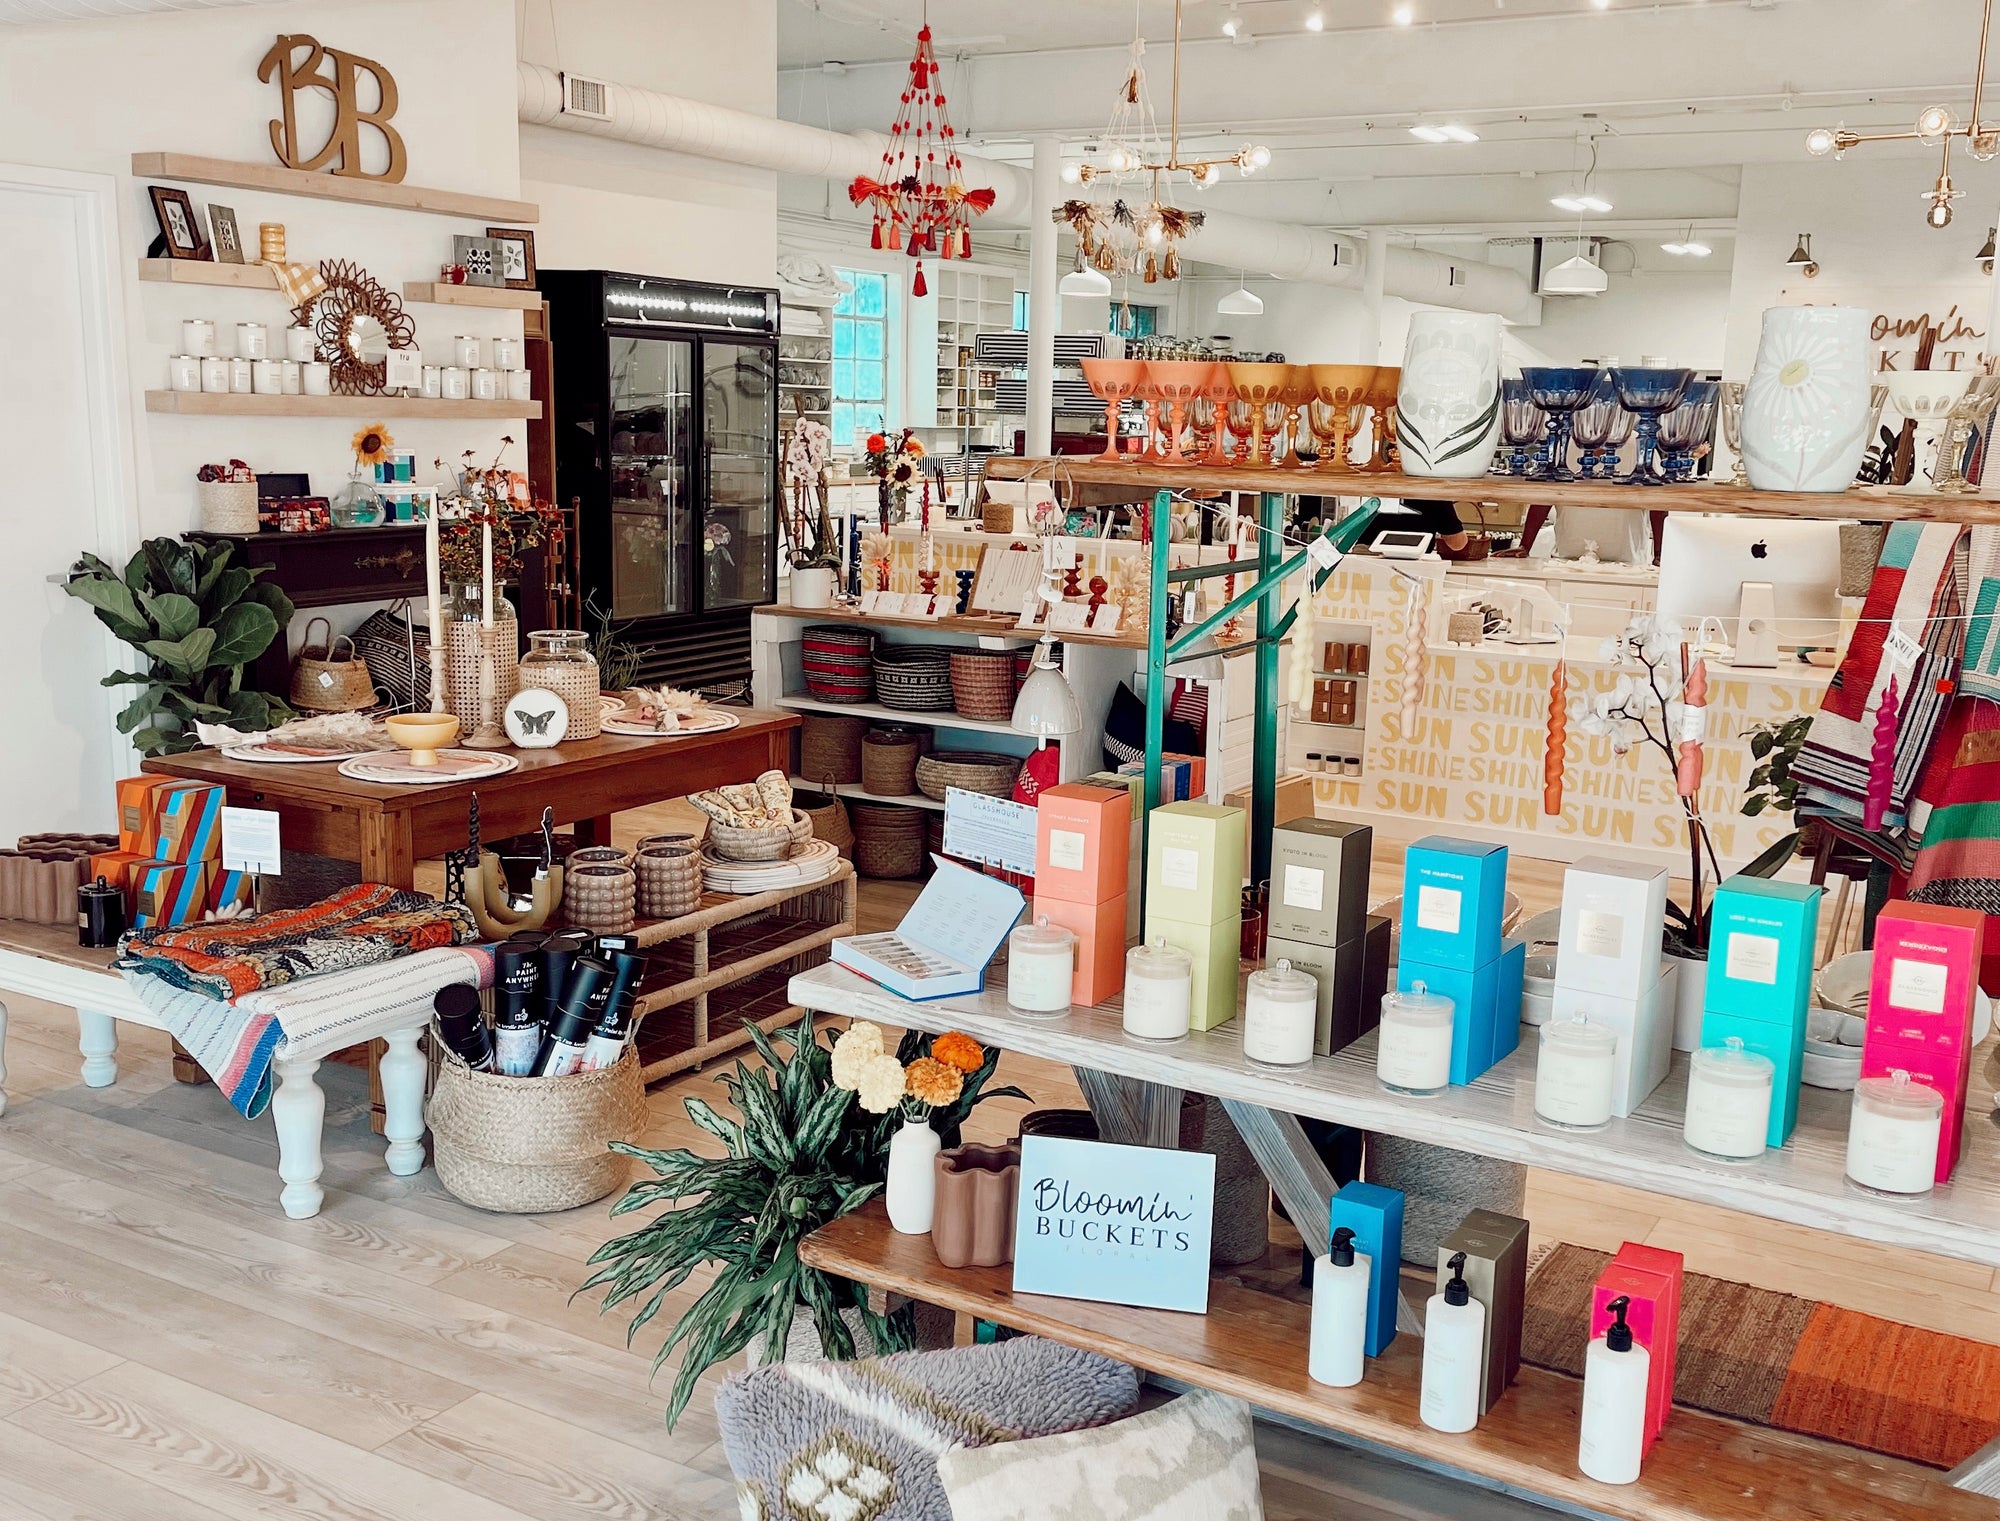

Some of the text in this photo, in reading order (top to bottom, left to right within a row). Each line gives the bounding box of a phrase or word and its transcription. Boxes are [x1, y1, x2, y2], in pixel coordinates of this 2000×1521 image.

[1313, 571, 1372, 605] UN
[1472, 687, 1545, 720] SHIN
[1473, 658, 1548, 690] SUN
[1768, 684, 1826, 714] SU
[1468, 721, 1544, 761] SUN
[1380, 746, 1465, 781] SHINE
[1468, 757, 1546, 791] SHIN
[1563, 766, 1653, 804] SHINE
[972, 801, 1020, 820] GLASSHOUSE
[1315, 778, 1360, 807] UN
[1375, 779, 1448, 818] SUN
[1464, 790, 1539, 831] SUN
[1555, 802, 1634, 843] SUN
[516, 967, 537, 977] PAINT
[1033, 1177, 1193, 1223] Bloomin'
[1036, 1216, 1190, 1252] BUCKETS
